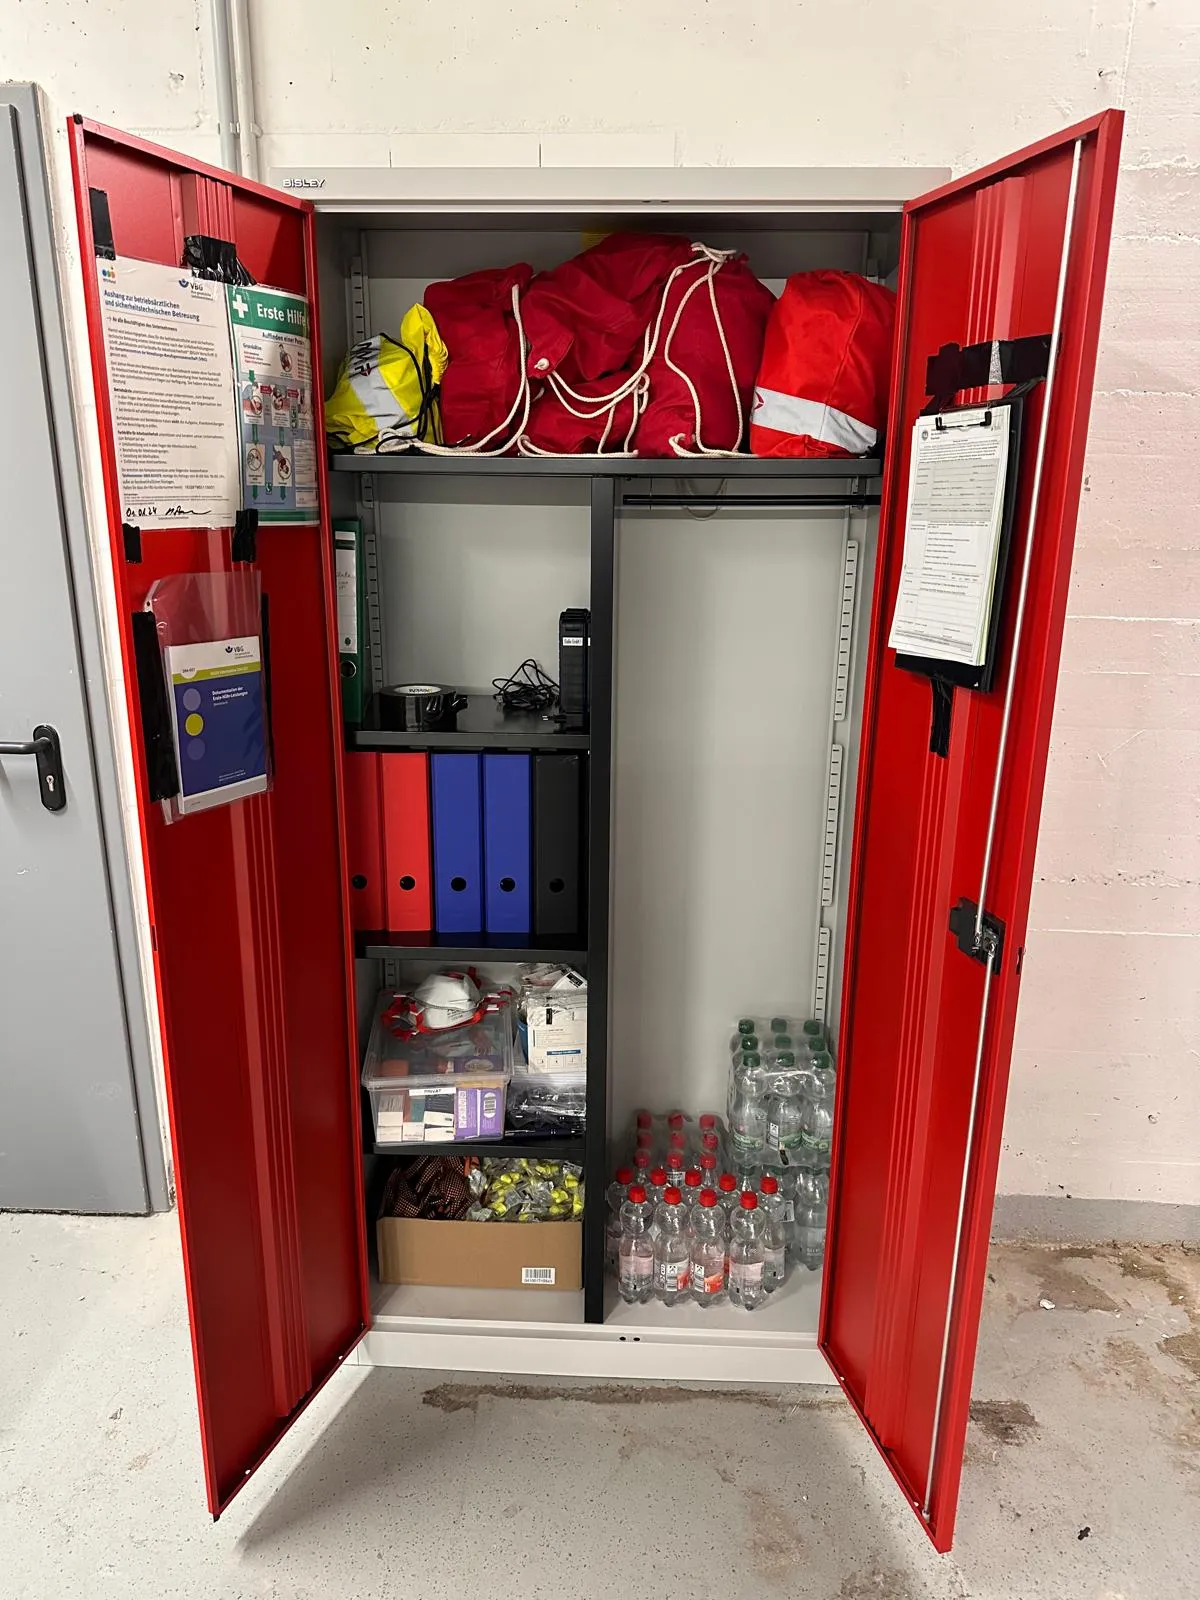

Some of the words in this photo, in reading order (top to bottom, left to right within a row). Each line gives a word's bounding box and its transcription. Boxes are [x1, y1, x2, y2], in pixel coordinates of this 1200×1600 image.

[282, 178, 326, 188] BISLEY
[105, 299, 115, 308] und
[257, 303, 285, 322] Erste
